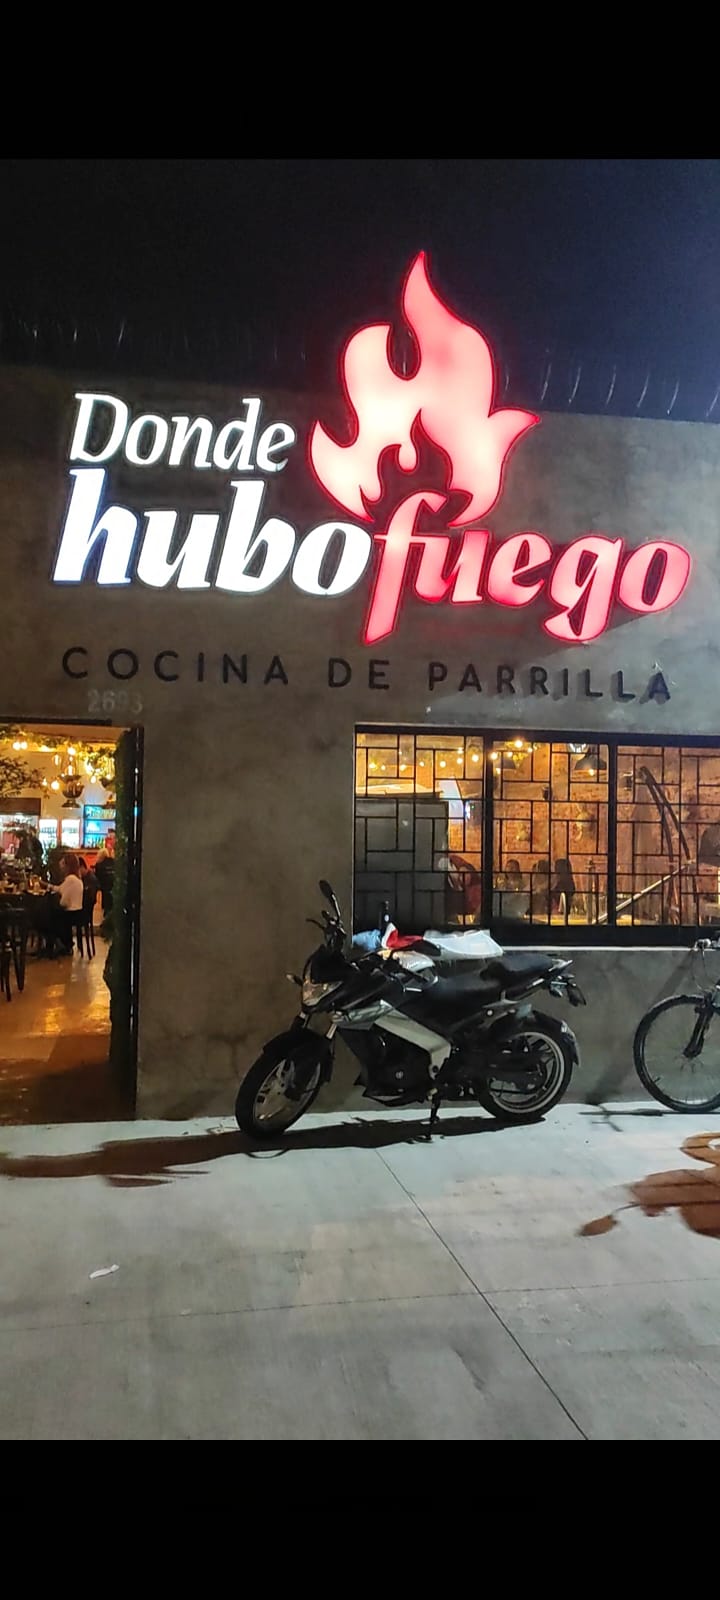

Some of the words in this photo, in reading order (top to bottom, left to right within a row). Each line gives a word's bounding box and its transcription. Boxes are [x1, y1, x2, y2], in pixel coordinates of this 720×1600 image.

[69, 392, 296, 473] Donde
[53, 467, 372, 597] hubo
[364, 490, 692, 644] fuego
[61, 646, 289, 685] COCINA
[327, 657, 391, 691] DE
[428, 661, 672, 701] PARRILLA
